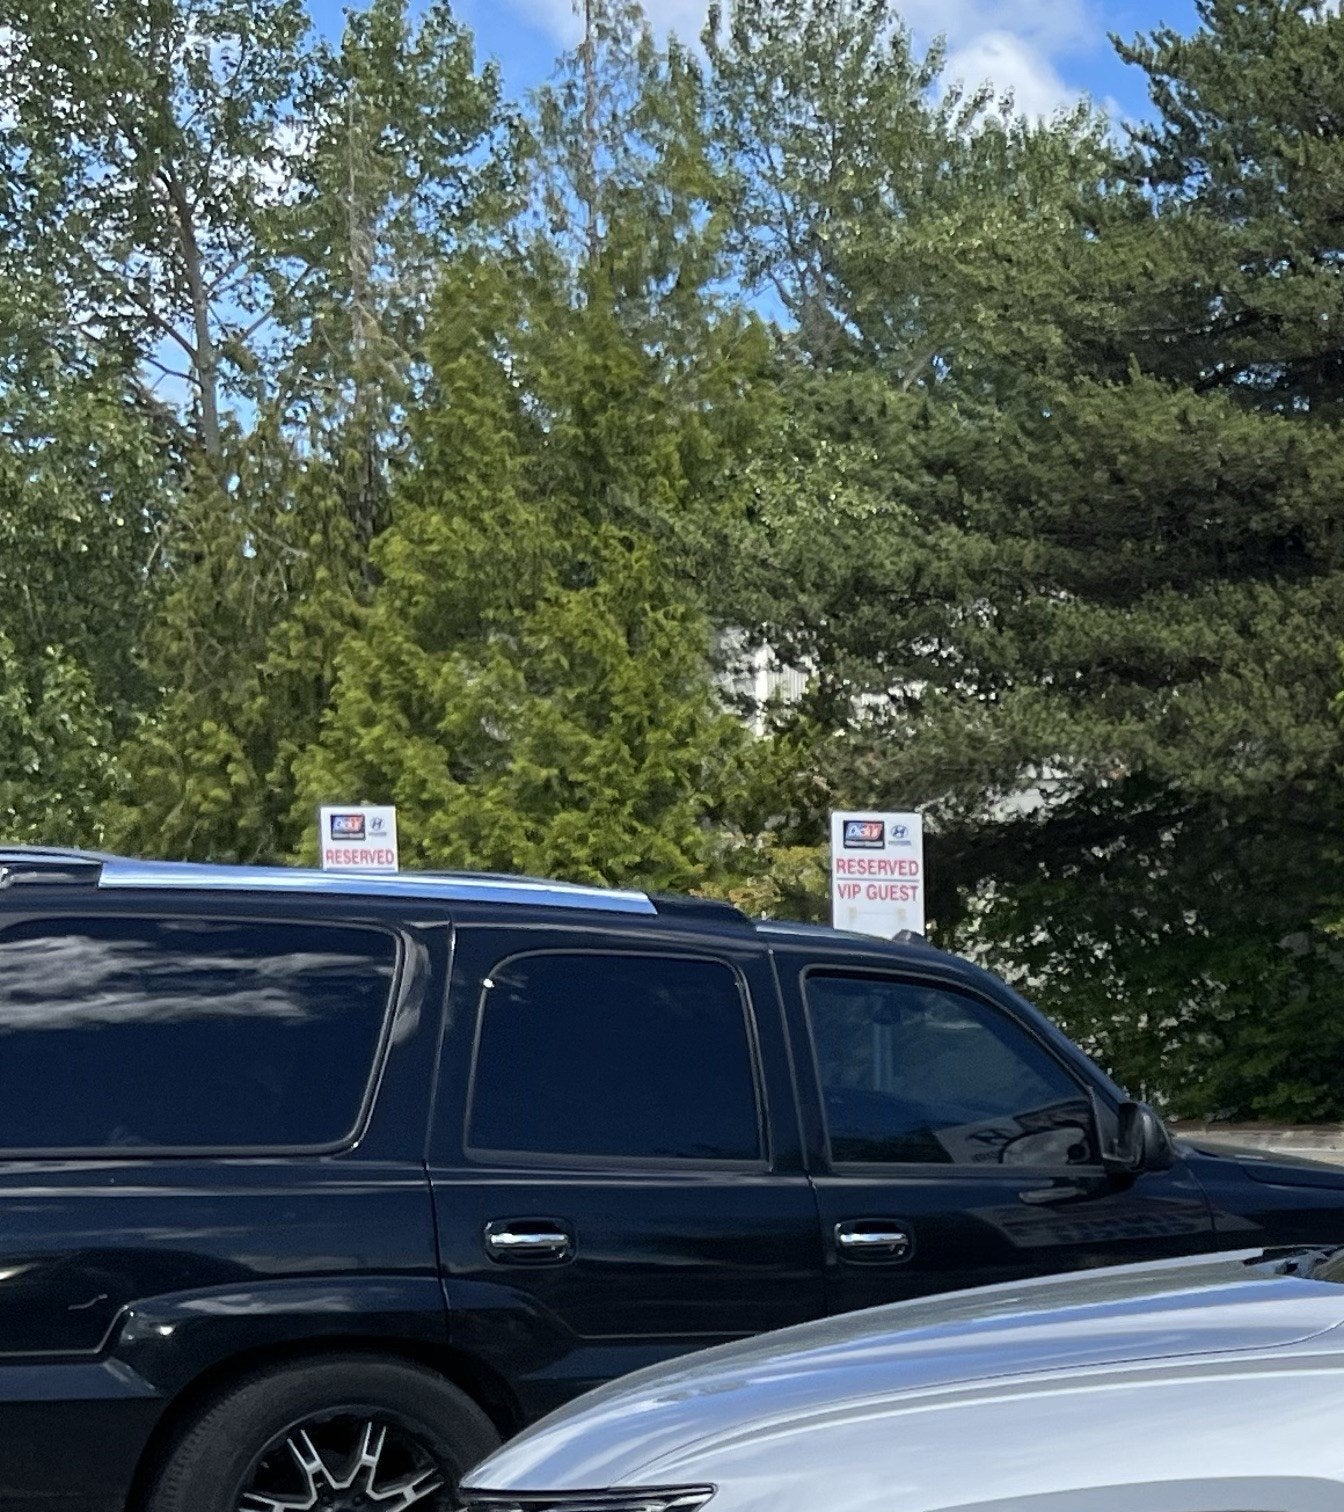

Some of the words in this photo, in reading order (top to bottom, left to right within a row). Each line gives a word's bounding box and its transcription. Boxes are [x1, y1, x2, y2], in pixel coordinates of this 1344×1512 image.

[325, 848, 395, 865] RESERVED
[836, 858, 919, 876] RESERVED
[837, 883, 861, 900] VIP
[866, 883, 919, 902] GUEST
